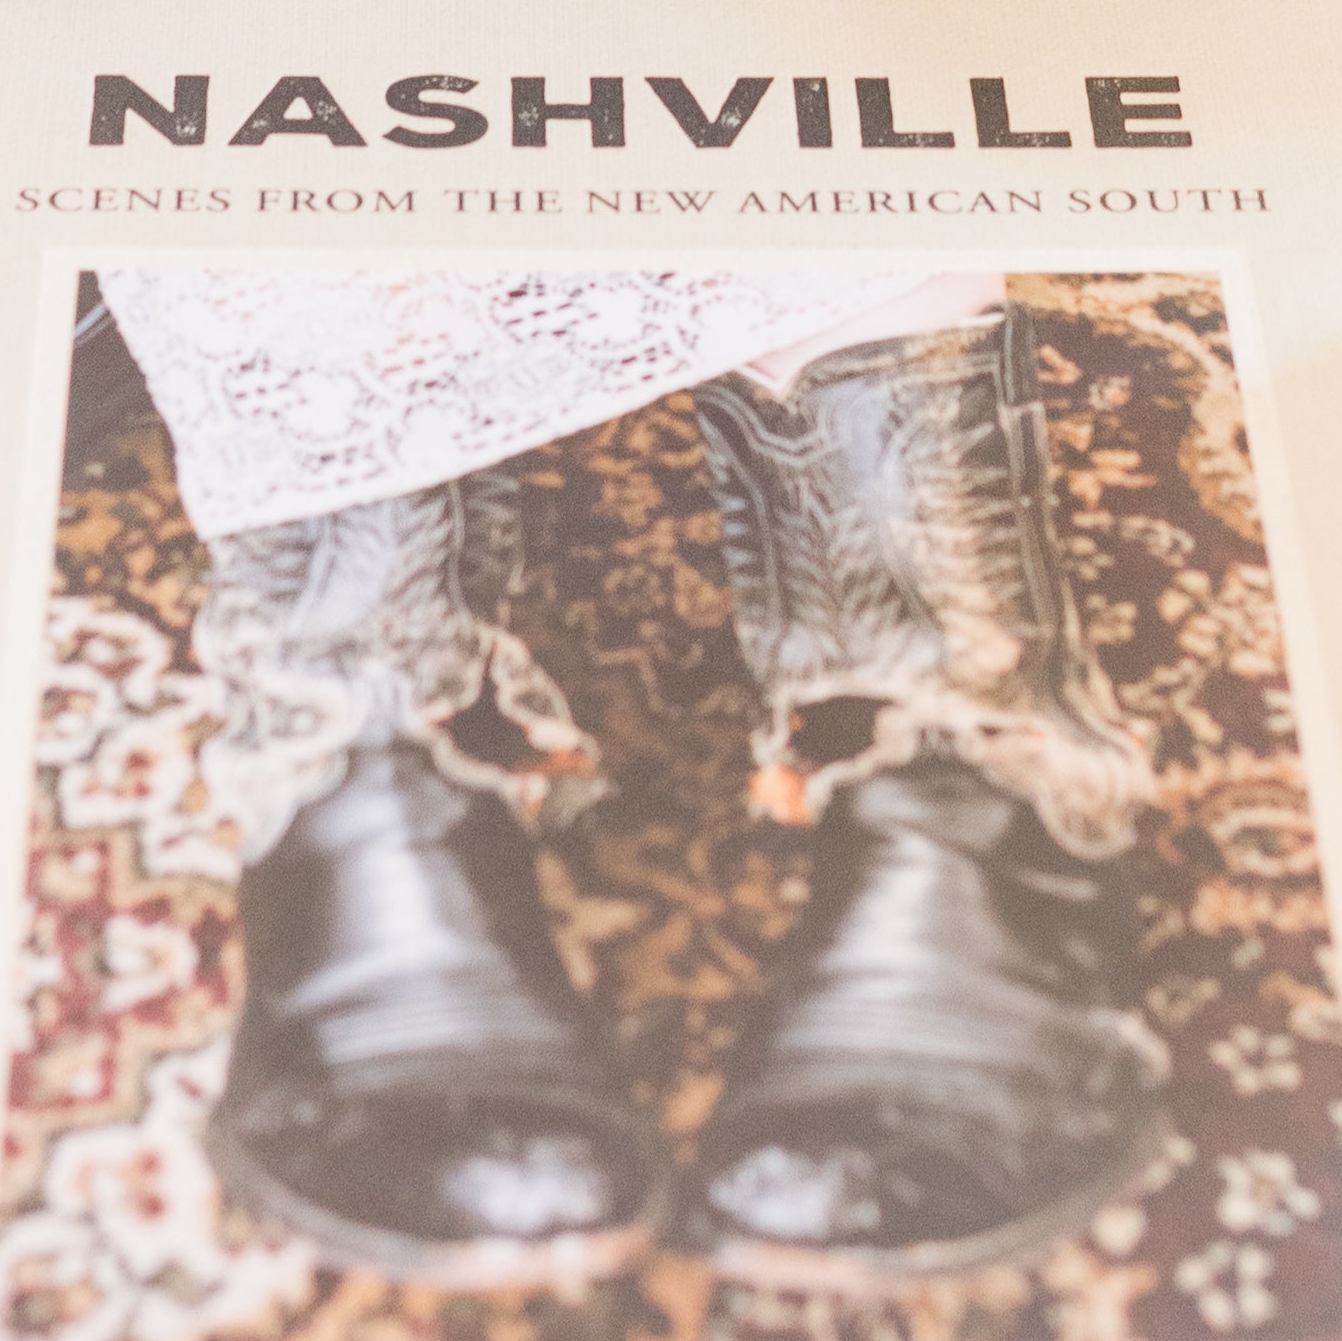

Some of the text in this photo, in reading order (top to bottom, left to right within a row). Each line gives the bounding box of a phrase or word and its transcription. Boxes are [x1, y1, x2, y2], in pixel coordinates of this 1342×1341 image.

[88, 73, 1194, 150] NASHVILLE
[14, 188, 1272, 214] SCENES FROM THE NEW AMERICAN SOUTH
